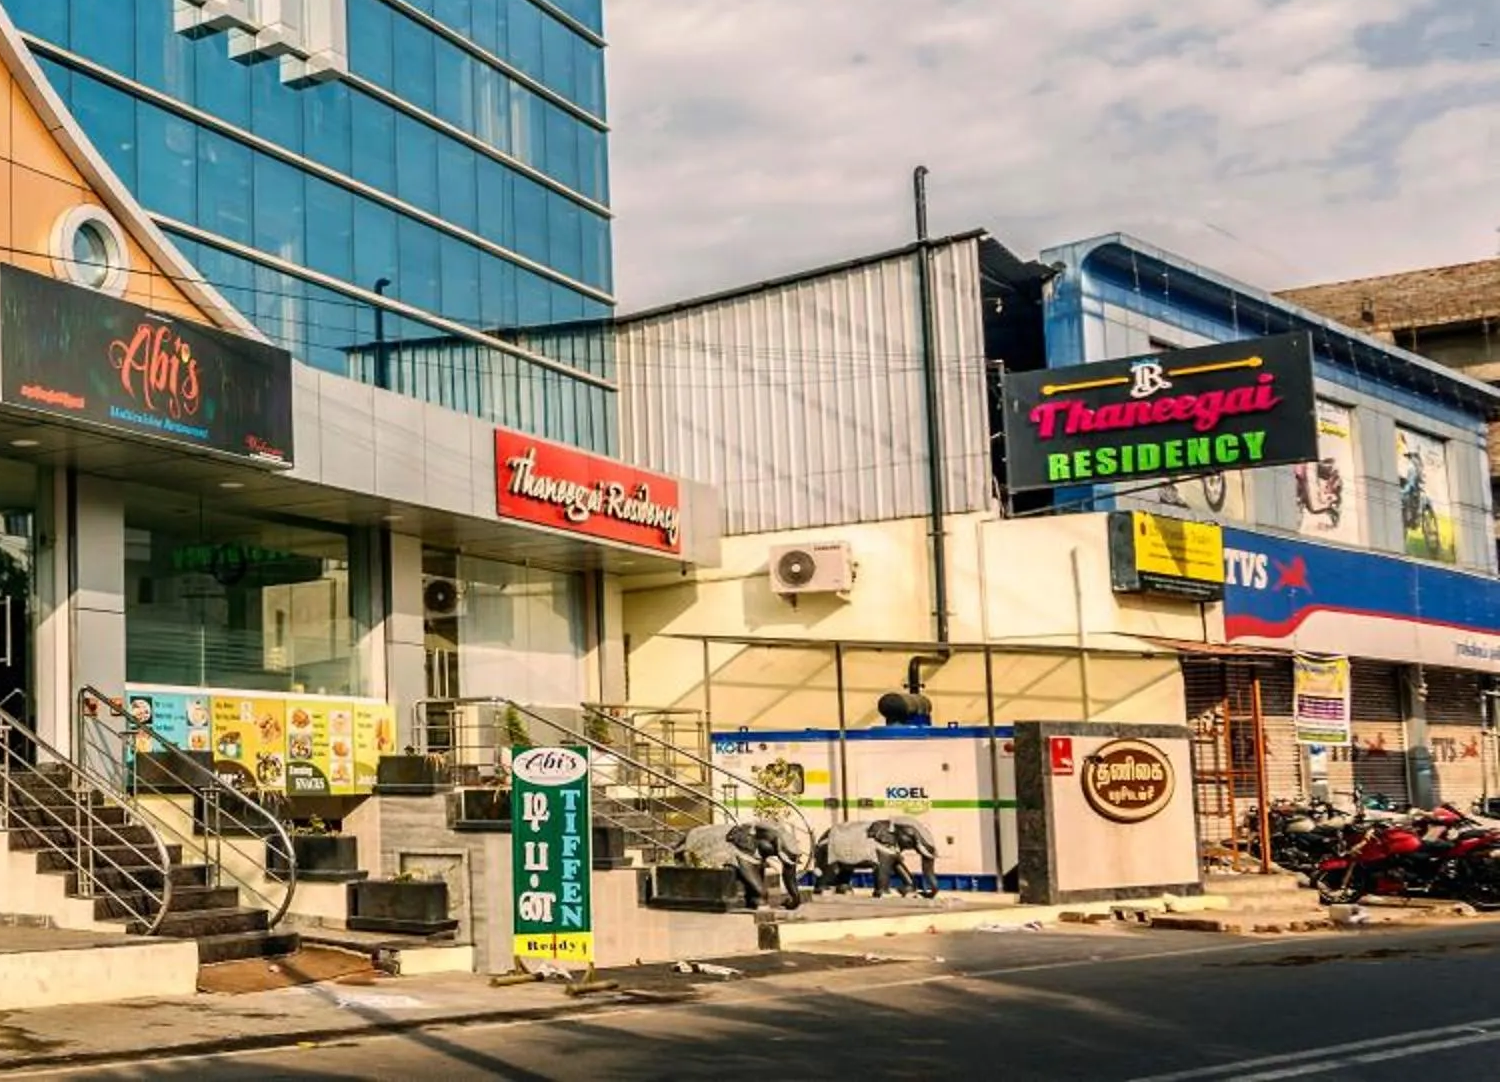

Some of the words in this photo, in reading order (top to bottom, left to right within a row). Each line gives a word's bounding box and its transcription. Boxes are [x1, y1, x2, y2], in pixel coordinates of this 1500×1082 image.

[108, 323, 200, 418] Abi's
[1030, 374, 1282, 437] Thaneegai
[1047, 431, 1266, 482] RESIDENCY
[1223, 547, 1269, 590] TVS
[715, 741, 753, 755] KOEL
[885, 786, 929, 799] KOEL
[560, 789, 582, 928] TIFFEN
[527, 940, 577, 954] Ready
